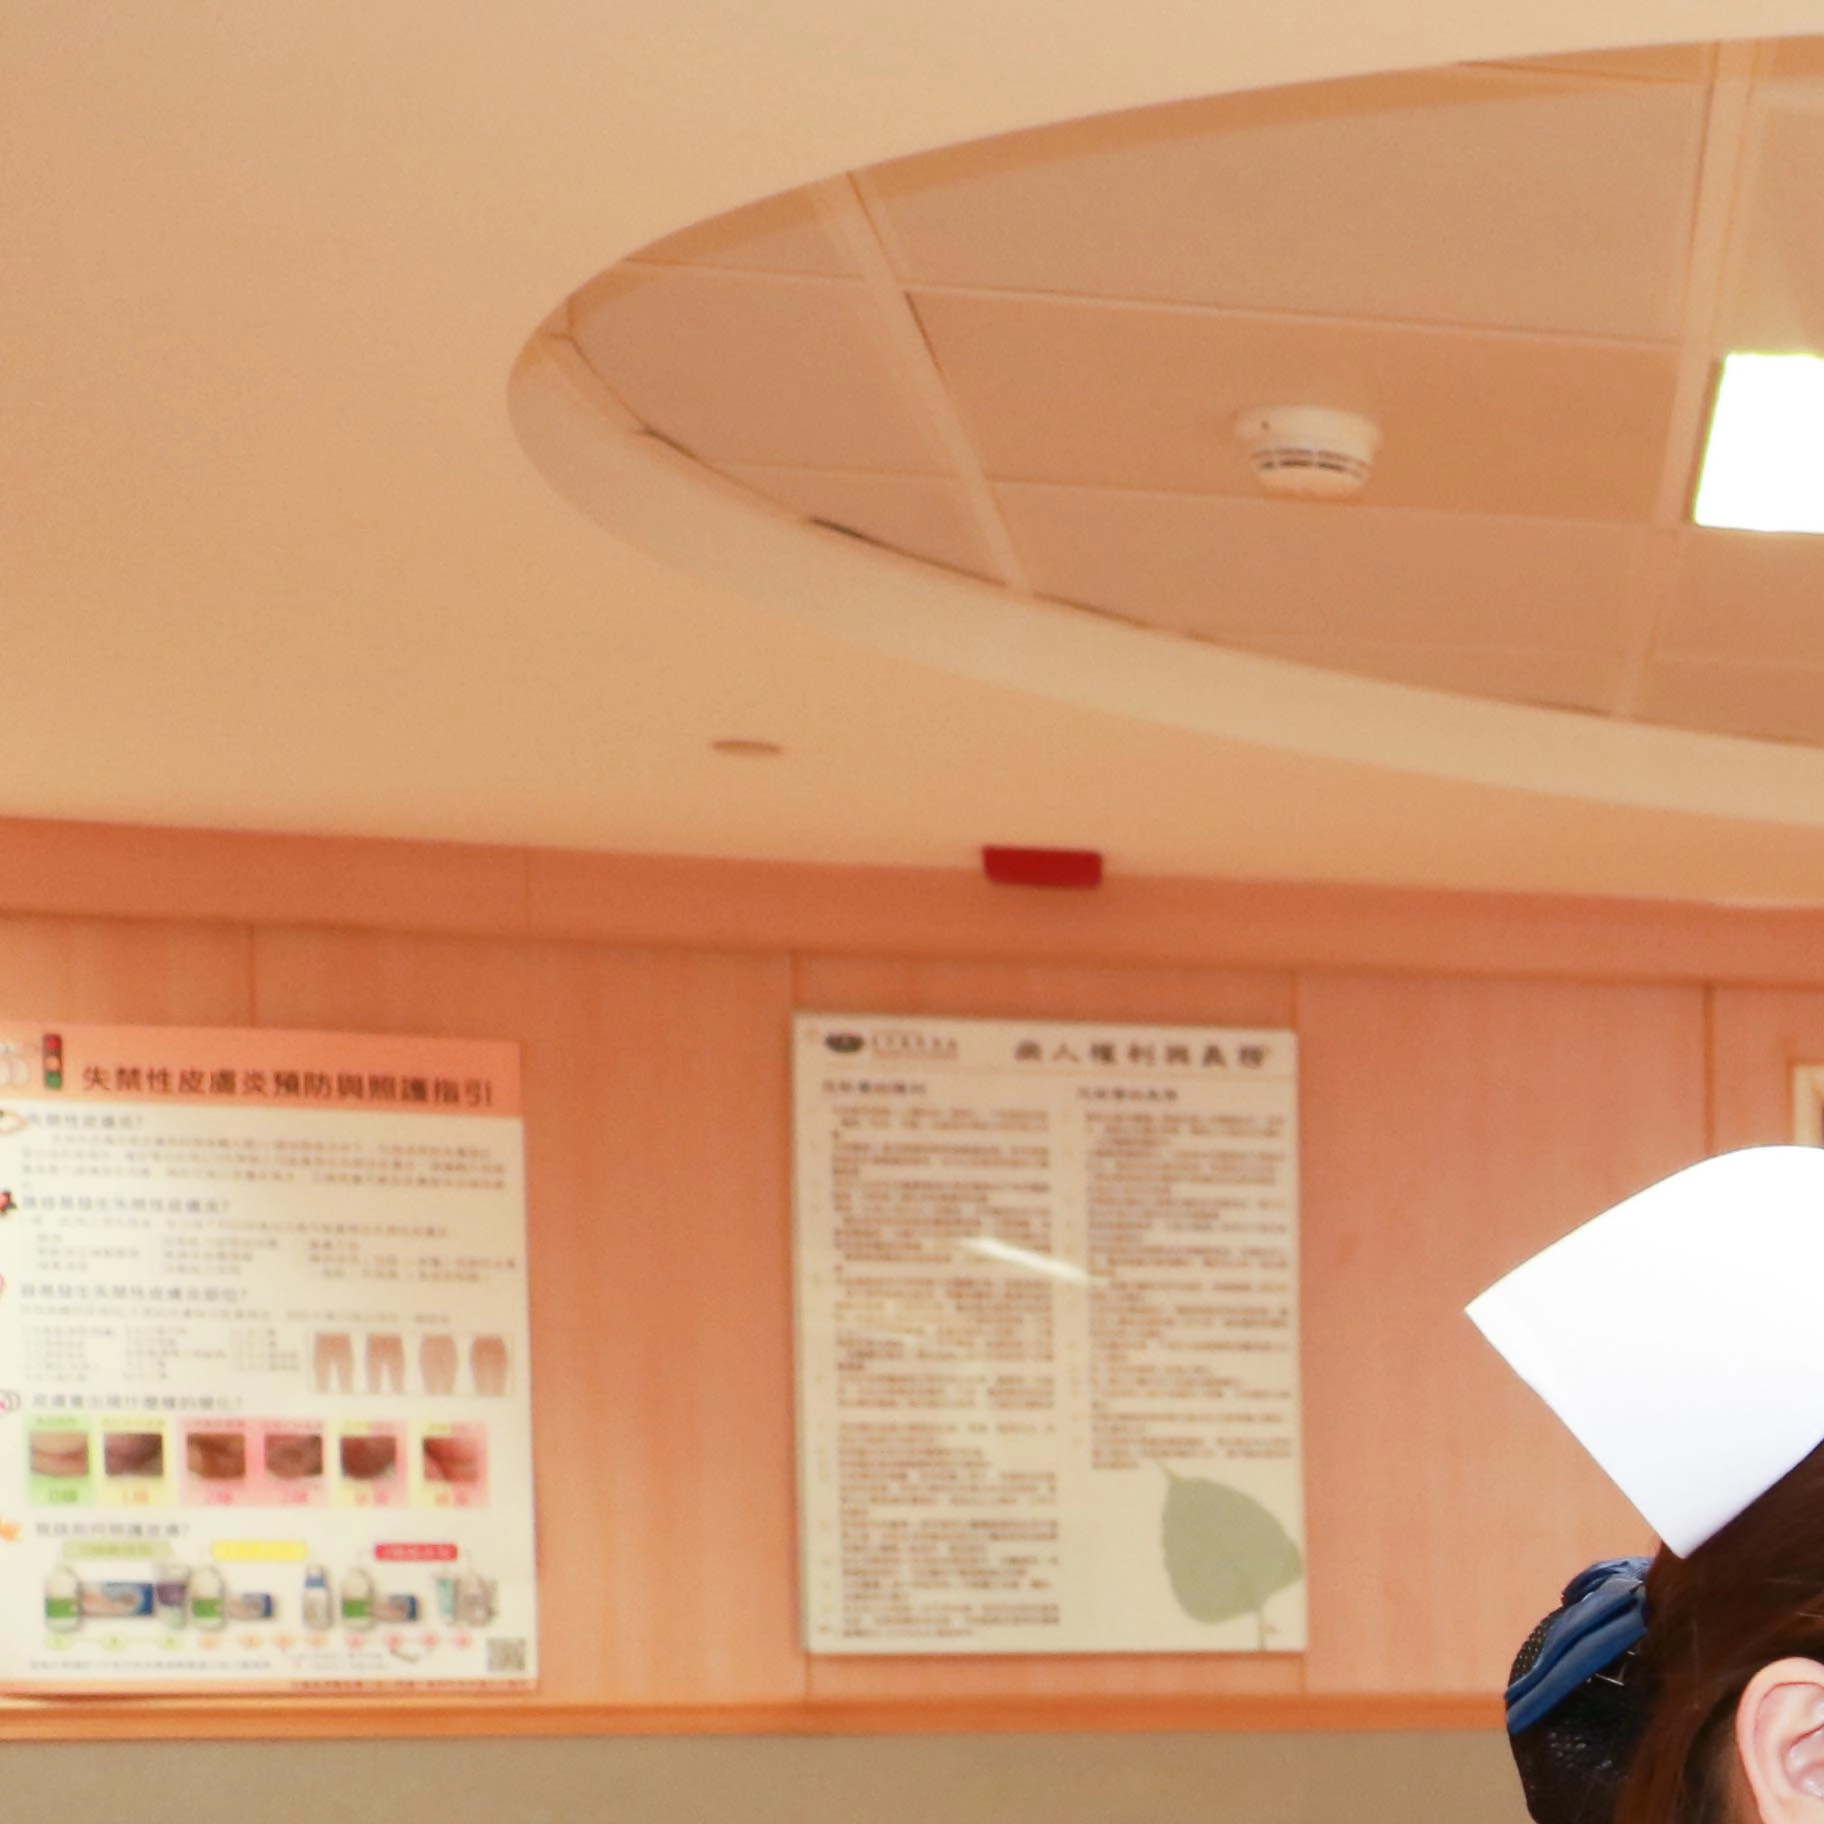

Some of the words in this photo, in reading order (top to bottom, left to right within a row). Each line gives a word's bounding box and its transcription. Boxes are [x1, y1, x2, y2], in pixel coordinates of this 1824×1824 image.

[82, 1065, 494, 1107] 失禁性皮膚炎預防與照護指引
